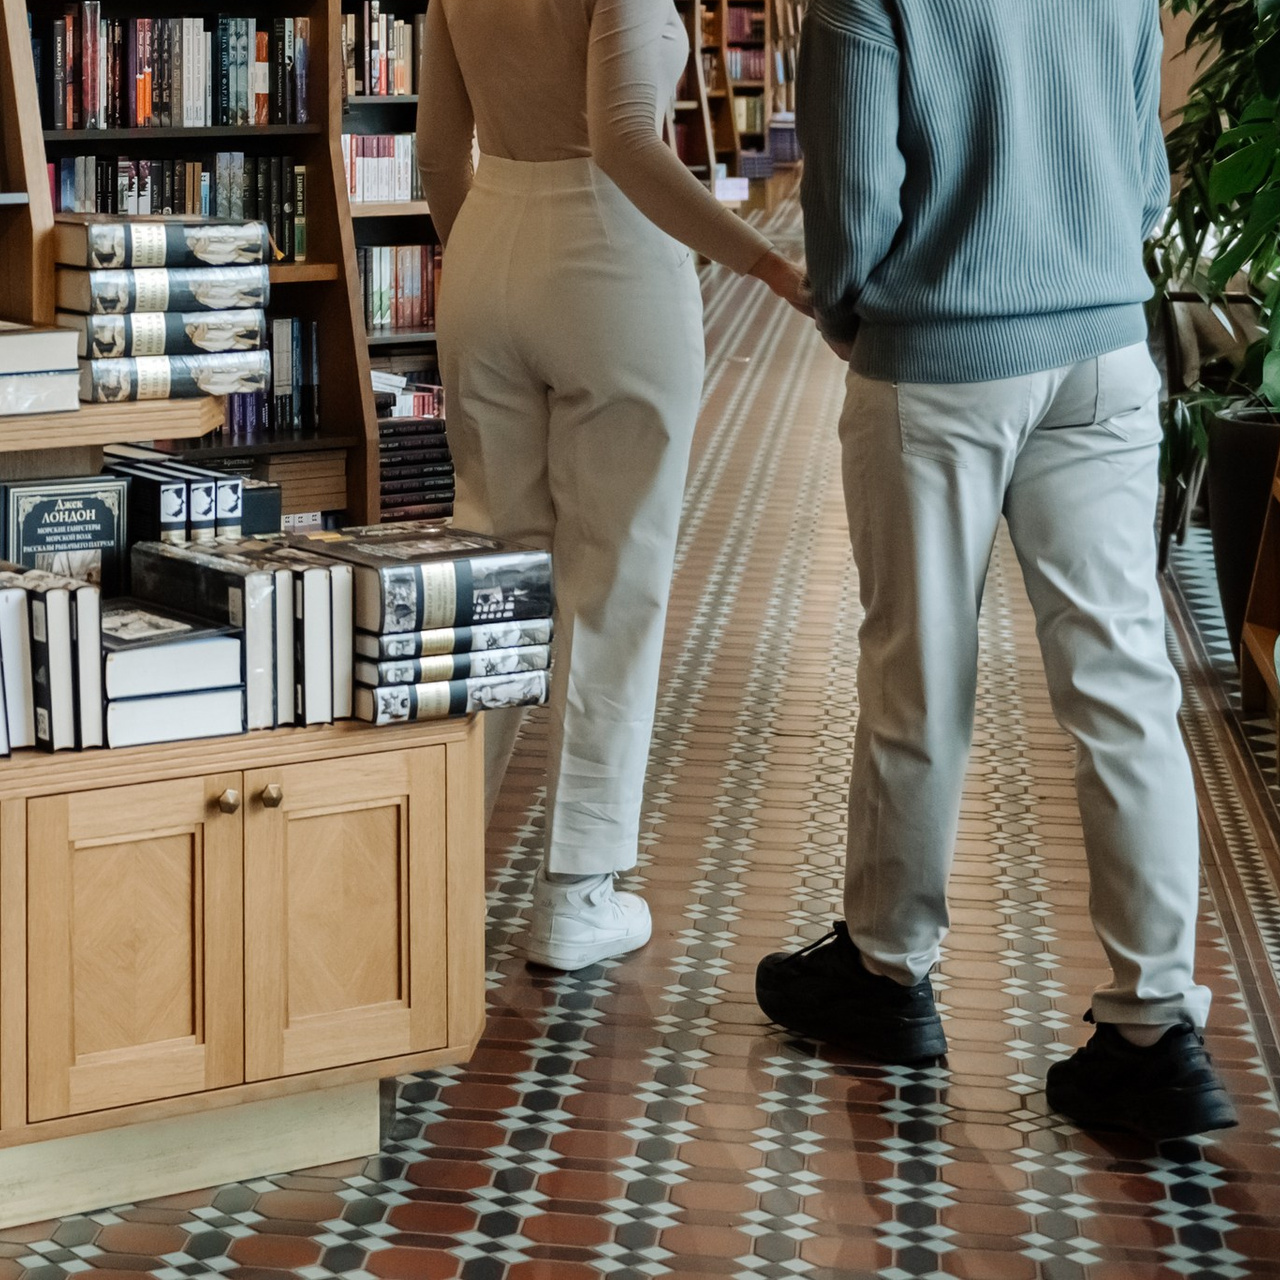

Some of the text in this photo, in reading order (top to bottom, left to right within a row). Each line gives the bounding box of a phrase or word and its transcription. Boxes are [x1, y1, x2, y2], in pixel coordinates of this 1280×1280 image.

[222, 36, 227, 48] НА
[55, 499, 83, 511] Джек
[42, 509, 96, 524] ЛОНДОН
[37, 526, 66, 534] МОРСКИЕ
[46, 534, 75, 542] МОРСКОЙ
[23, 544, 54, 553] РАССКАЗЫ
[55, 542, 88, 550] РЫБАЧЬЕГО
